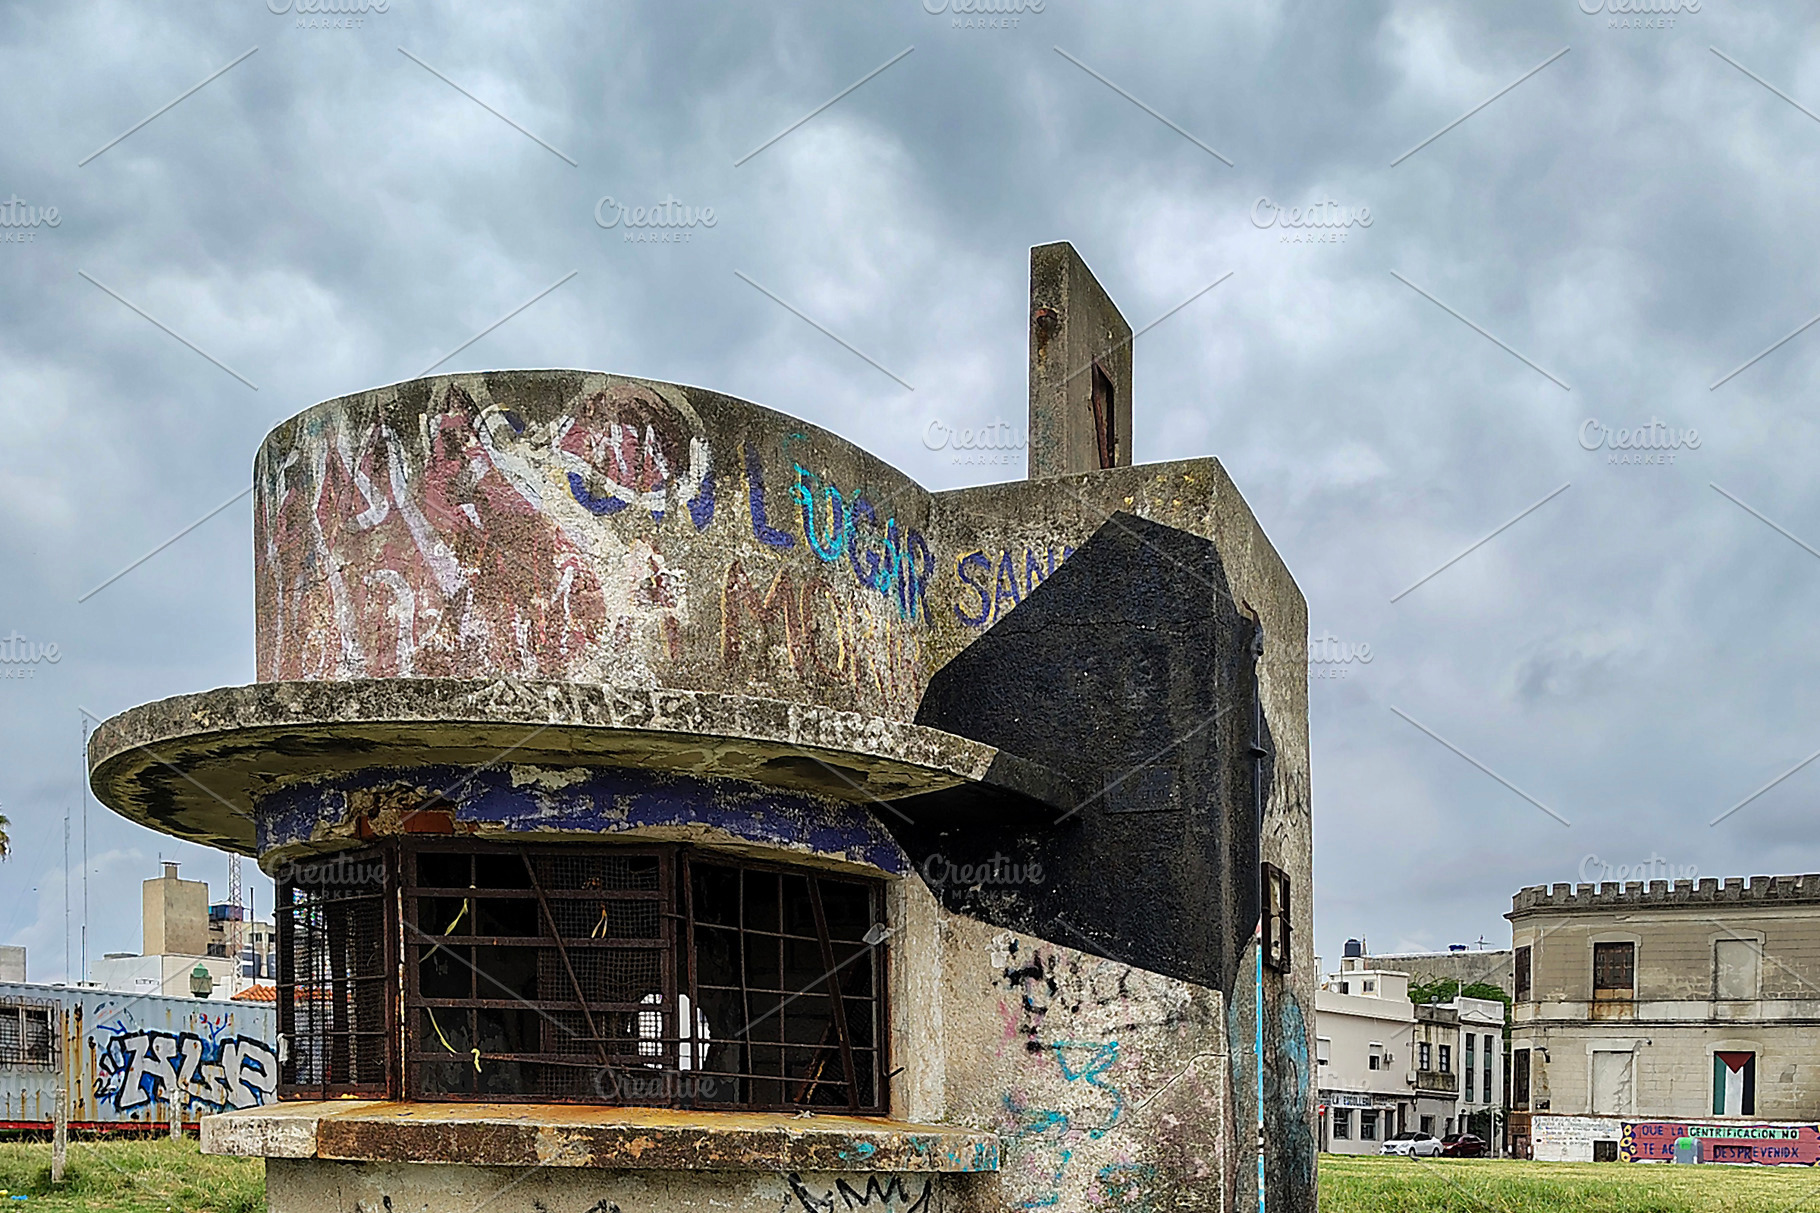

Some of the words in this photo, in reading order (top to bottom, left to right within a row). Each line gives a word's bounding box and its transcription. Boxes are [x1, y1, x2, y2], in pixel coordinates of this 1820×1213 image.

[953, 544, 1077, 628] SAN
[1671, 1126, 1684, 1136] LA
[1781, 1129, 1798, 1139] NO
[1643, 1142, 1655, 1155] TE
